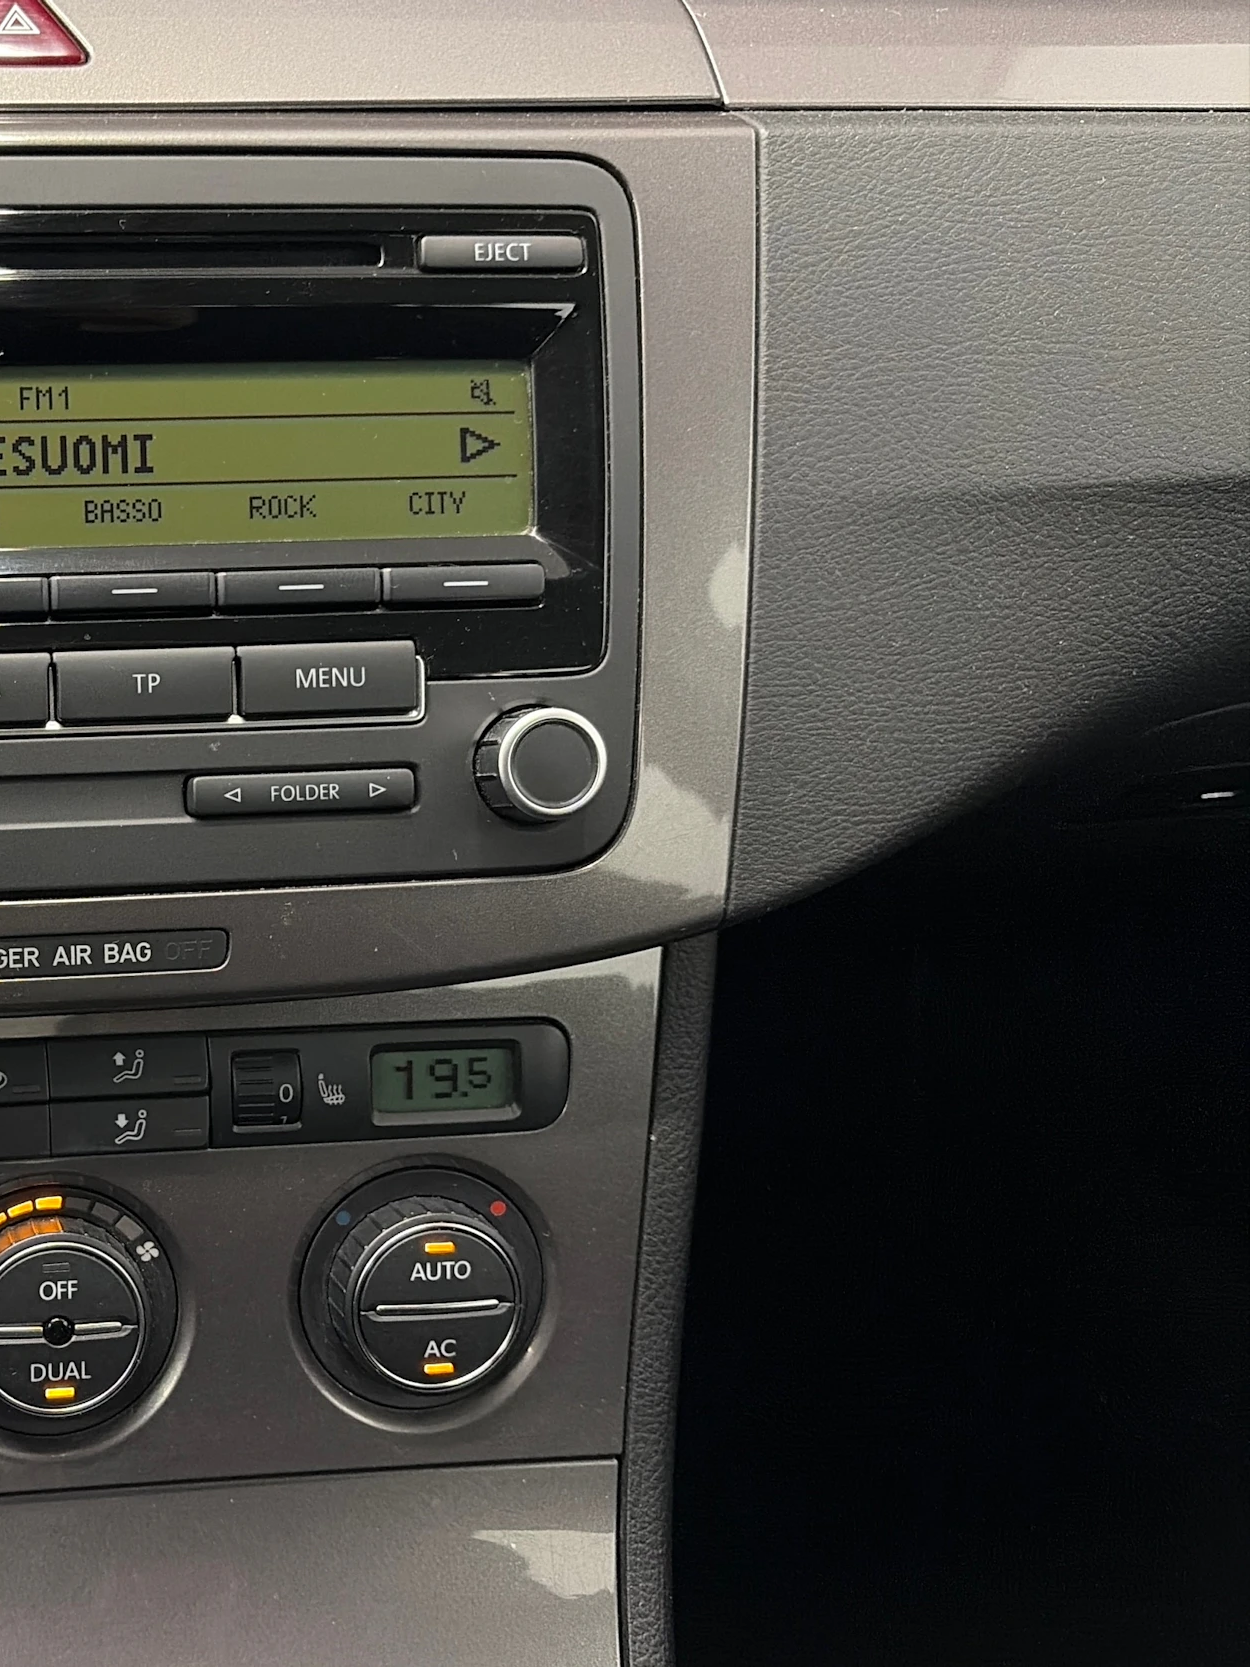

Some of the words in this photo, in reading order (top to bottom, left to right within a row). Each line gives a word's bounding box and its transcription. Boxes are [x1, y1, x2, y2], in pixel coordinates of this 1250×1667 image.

[474, 241, 531, 263] EJECT
[18, 386, 70, 411] FM1
[84, 499, 162, 524] BASSO
[249, 495, 317, 520] ROCK
[408, 490, 467, 516] CITY
[132, 674, 162, 694] TP
[295, 667, 366, 690] MENU
[270, 783, 340, 802] FOLDER
[53, 945, 92, 967] AIR
[103, 942, 152, 965] BAG
[164, 939, 214, 962] OFF
[410, 1260, 472, 1282] AUTO
[39, 1279, 78, 1302] OFF
[423, 1339, 457, 1359] AC
[29, 1360, 92, 1382] DUAL
